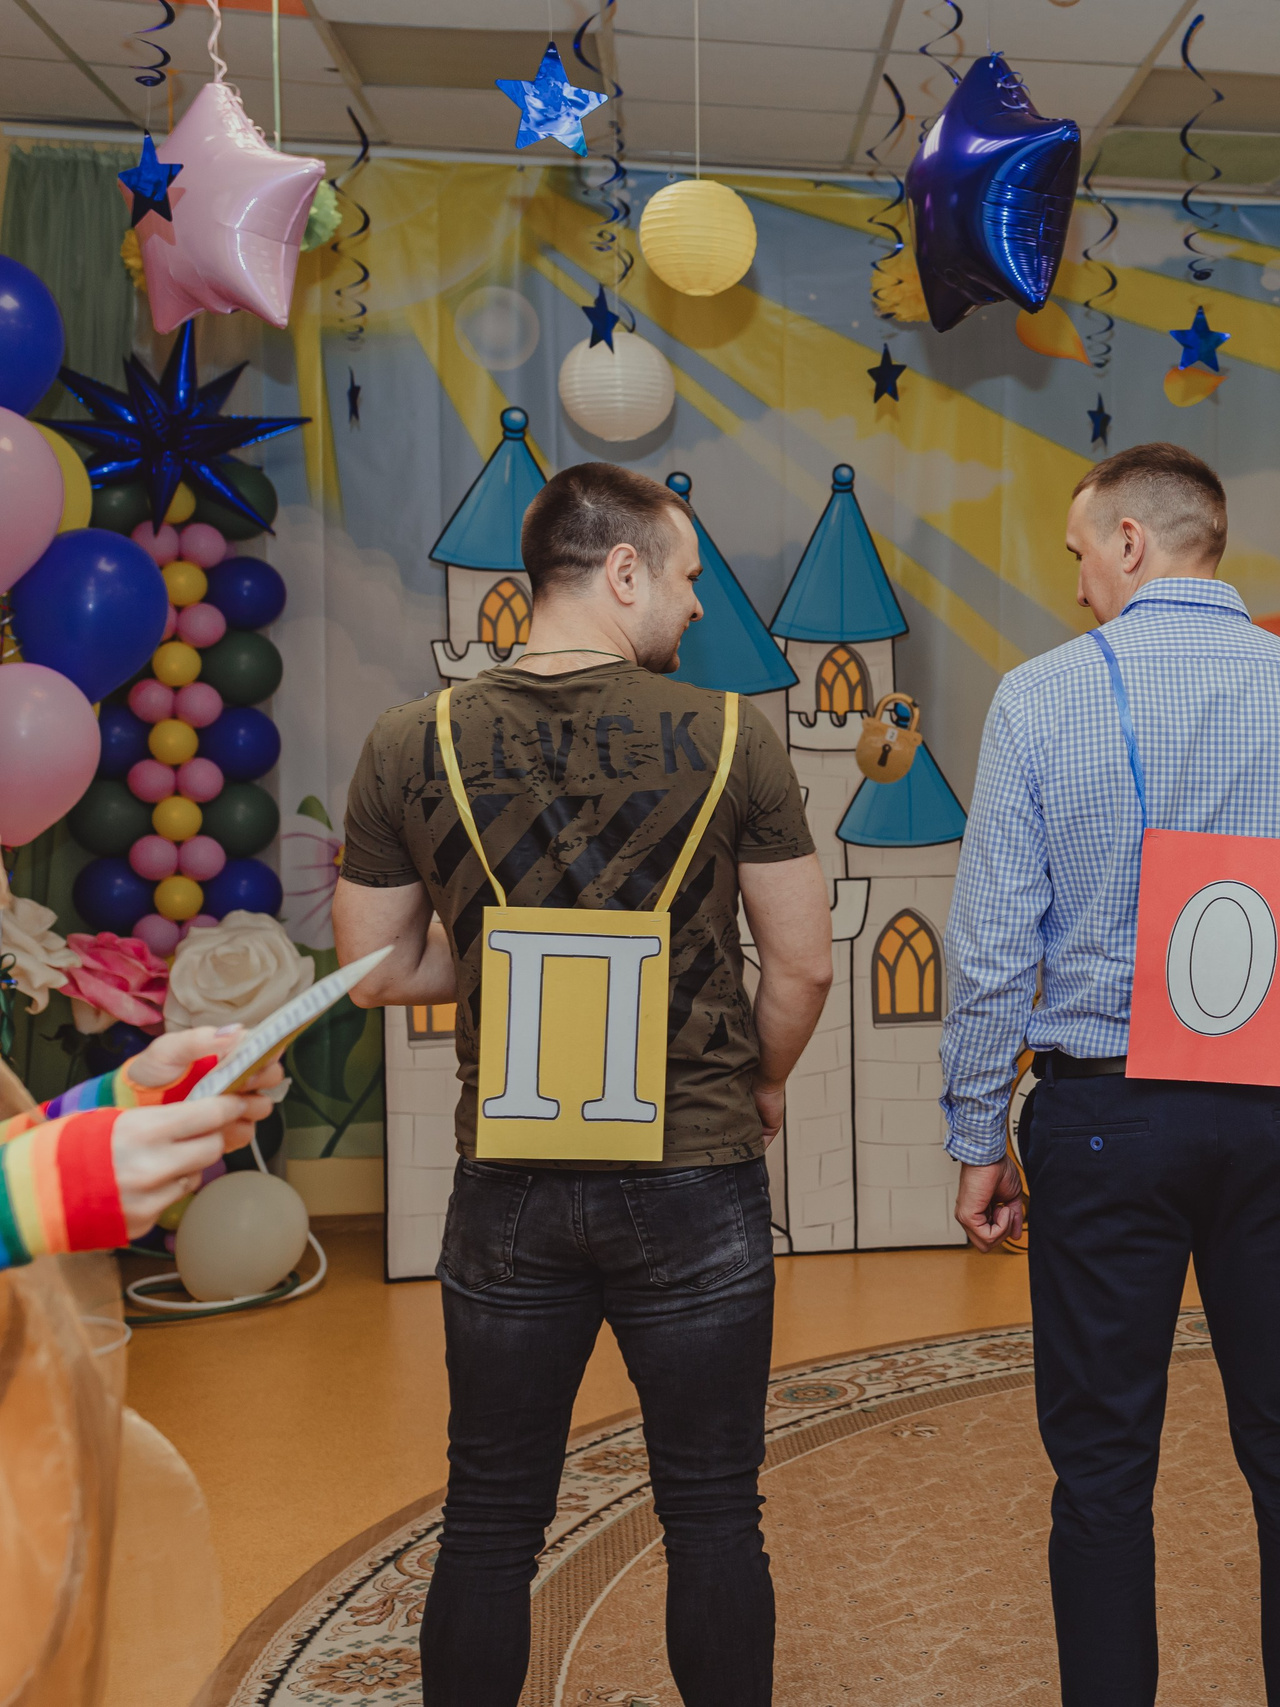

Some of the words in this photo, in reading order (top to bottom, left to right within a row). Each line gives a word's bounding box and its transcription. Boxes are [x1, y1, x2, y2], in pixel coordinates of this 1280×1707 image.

[423, 711, 706, 784] BLVCK
[483, 930, 661, 1123] П
[1166, 880, 1278, 1037] О
